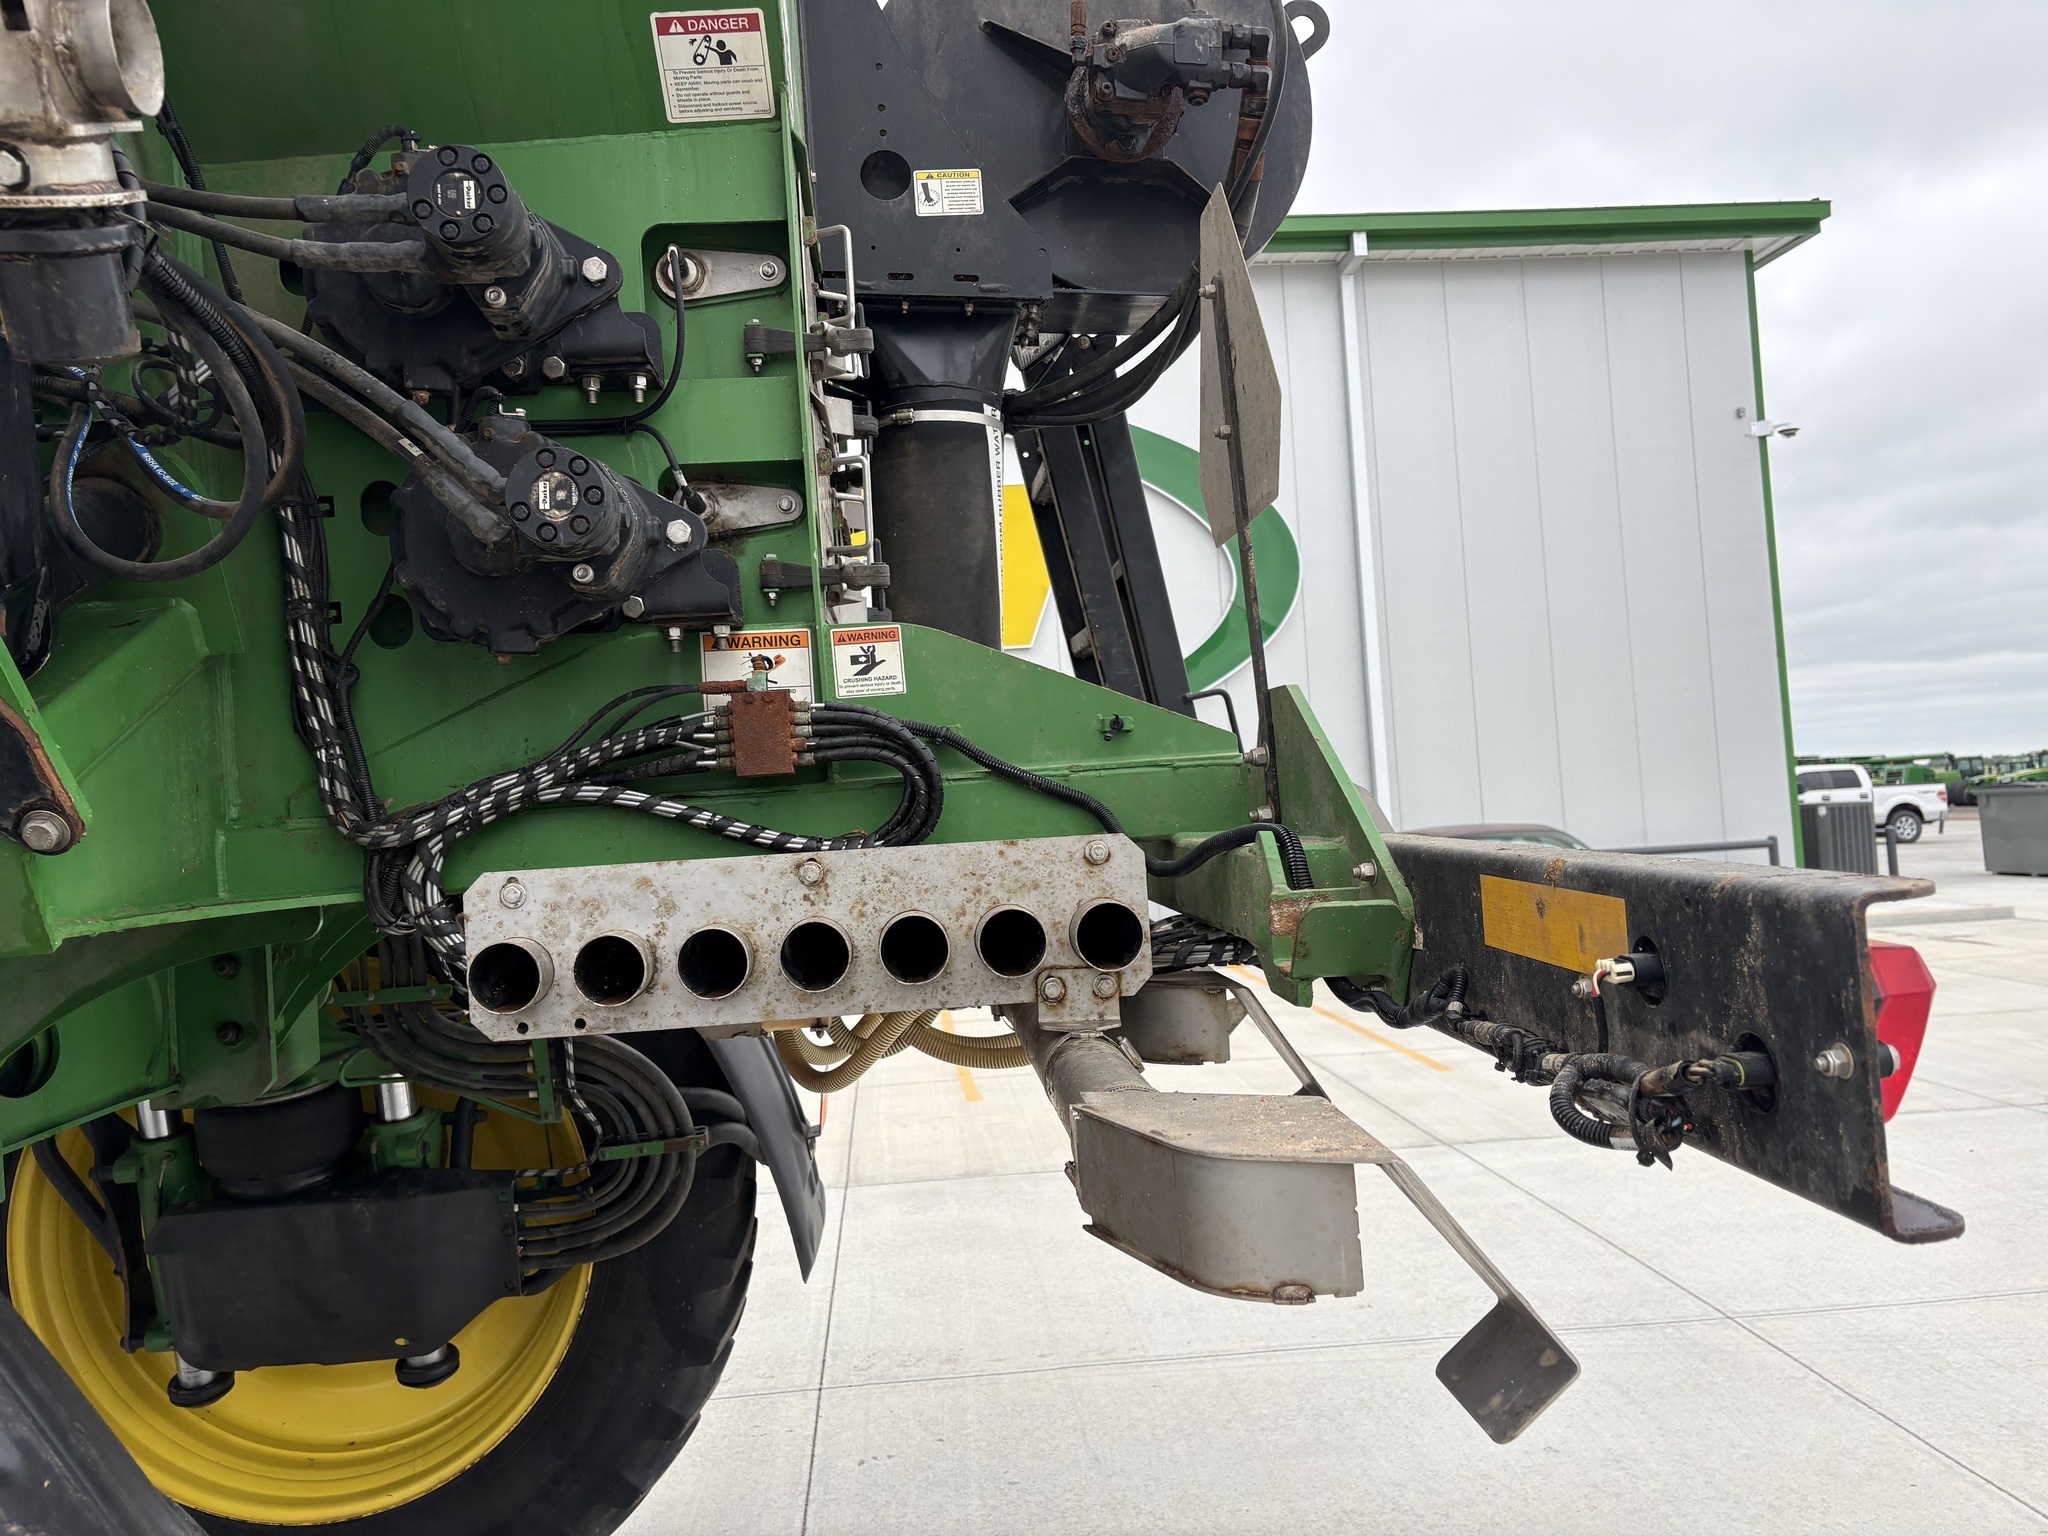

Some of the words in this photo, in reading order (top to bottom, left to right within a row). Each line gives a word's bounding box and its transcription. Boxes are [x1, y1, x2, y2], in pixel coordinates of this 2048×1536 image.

[687, 17, 749, 32] DANGER
[465, 183, 474, 208] Parker
[141, 452, 160, 470] MSHA
[727, 634, 801, 649] WARNING
[847, 631, 896, 642] WARNING
